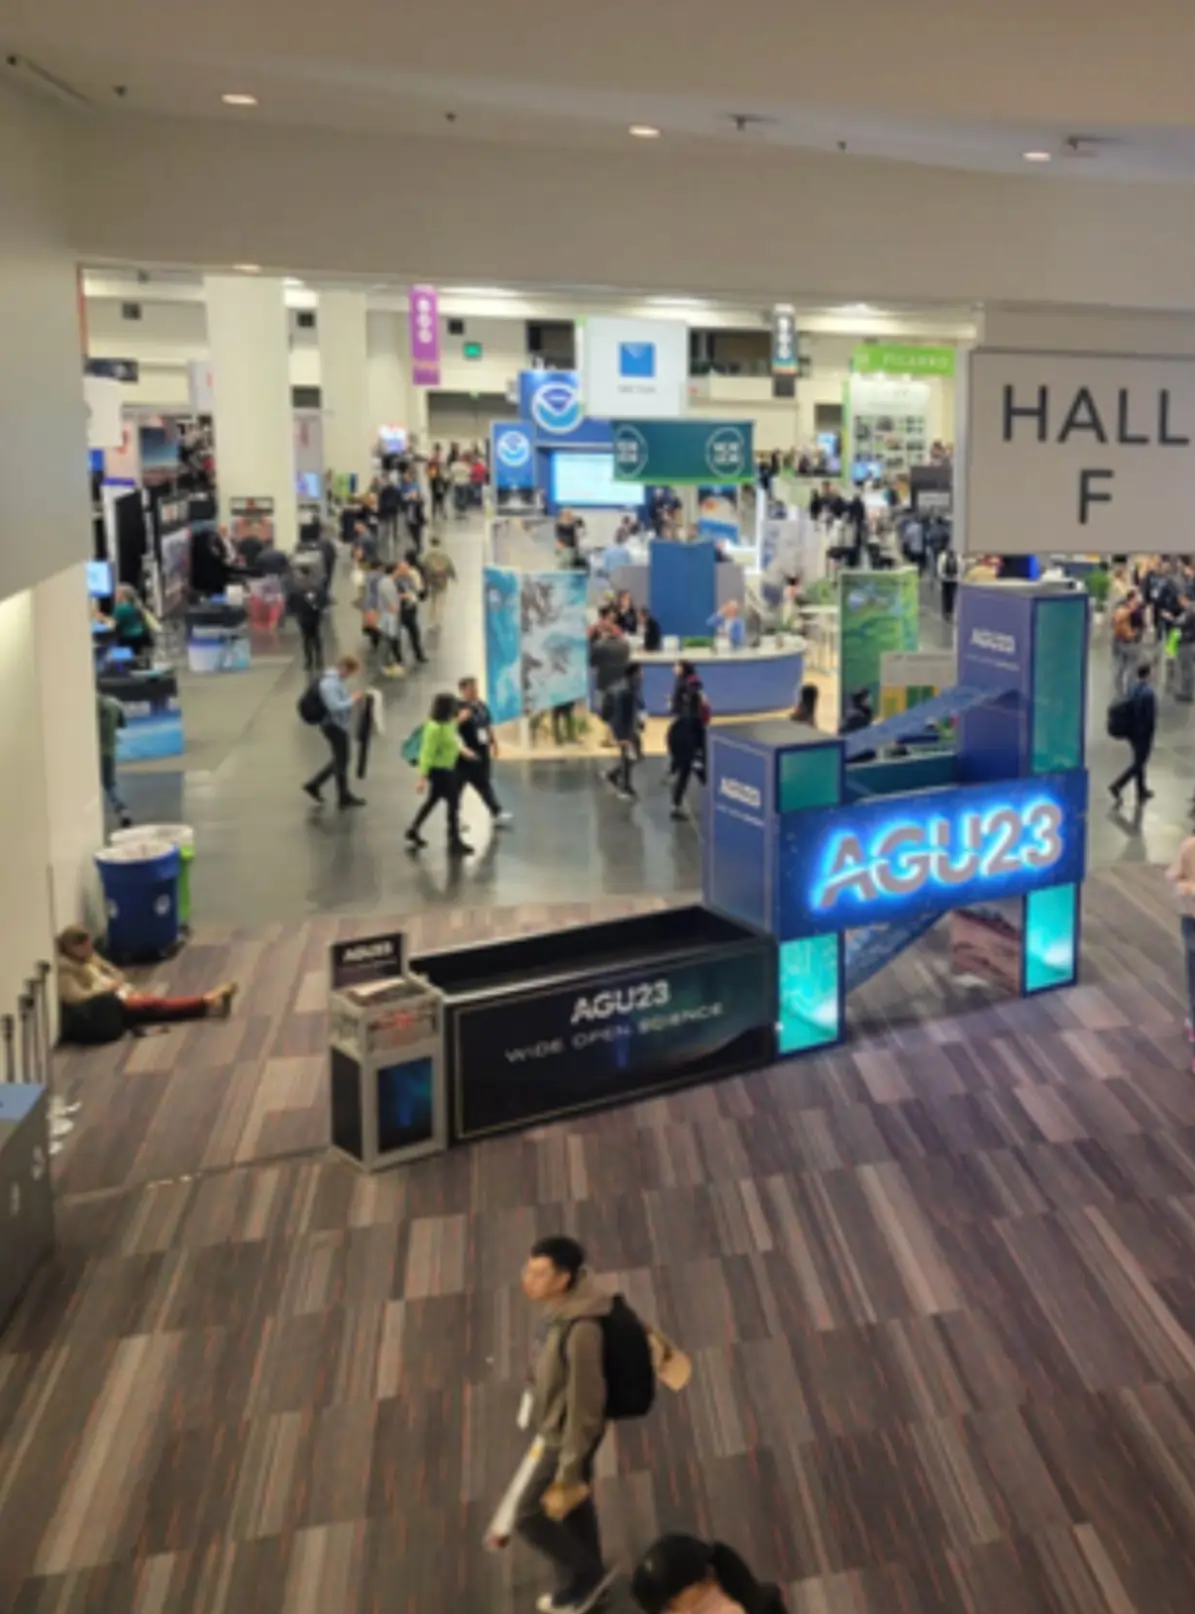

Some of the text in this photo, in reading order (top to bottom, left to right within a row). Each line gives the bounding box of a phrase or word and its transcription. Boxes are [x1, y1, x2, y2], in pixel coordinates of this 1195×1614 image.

[1003, 384, 1189, 446] HALL
[1077, 469, 1115, 525] F
[813, 802, 1065, 910] AGU23
[504, 1001, 724, 1063] WIDE OPEN SCIENCE
[570, 979, 672, 1025] AGU23
